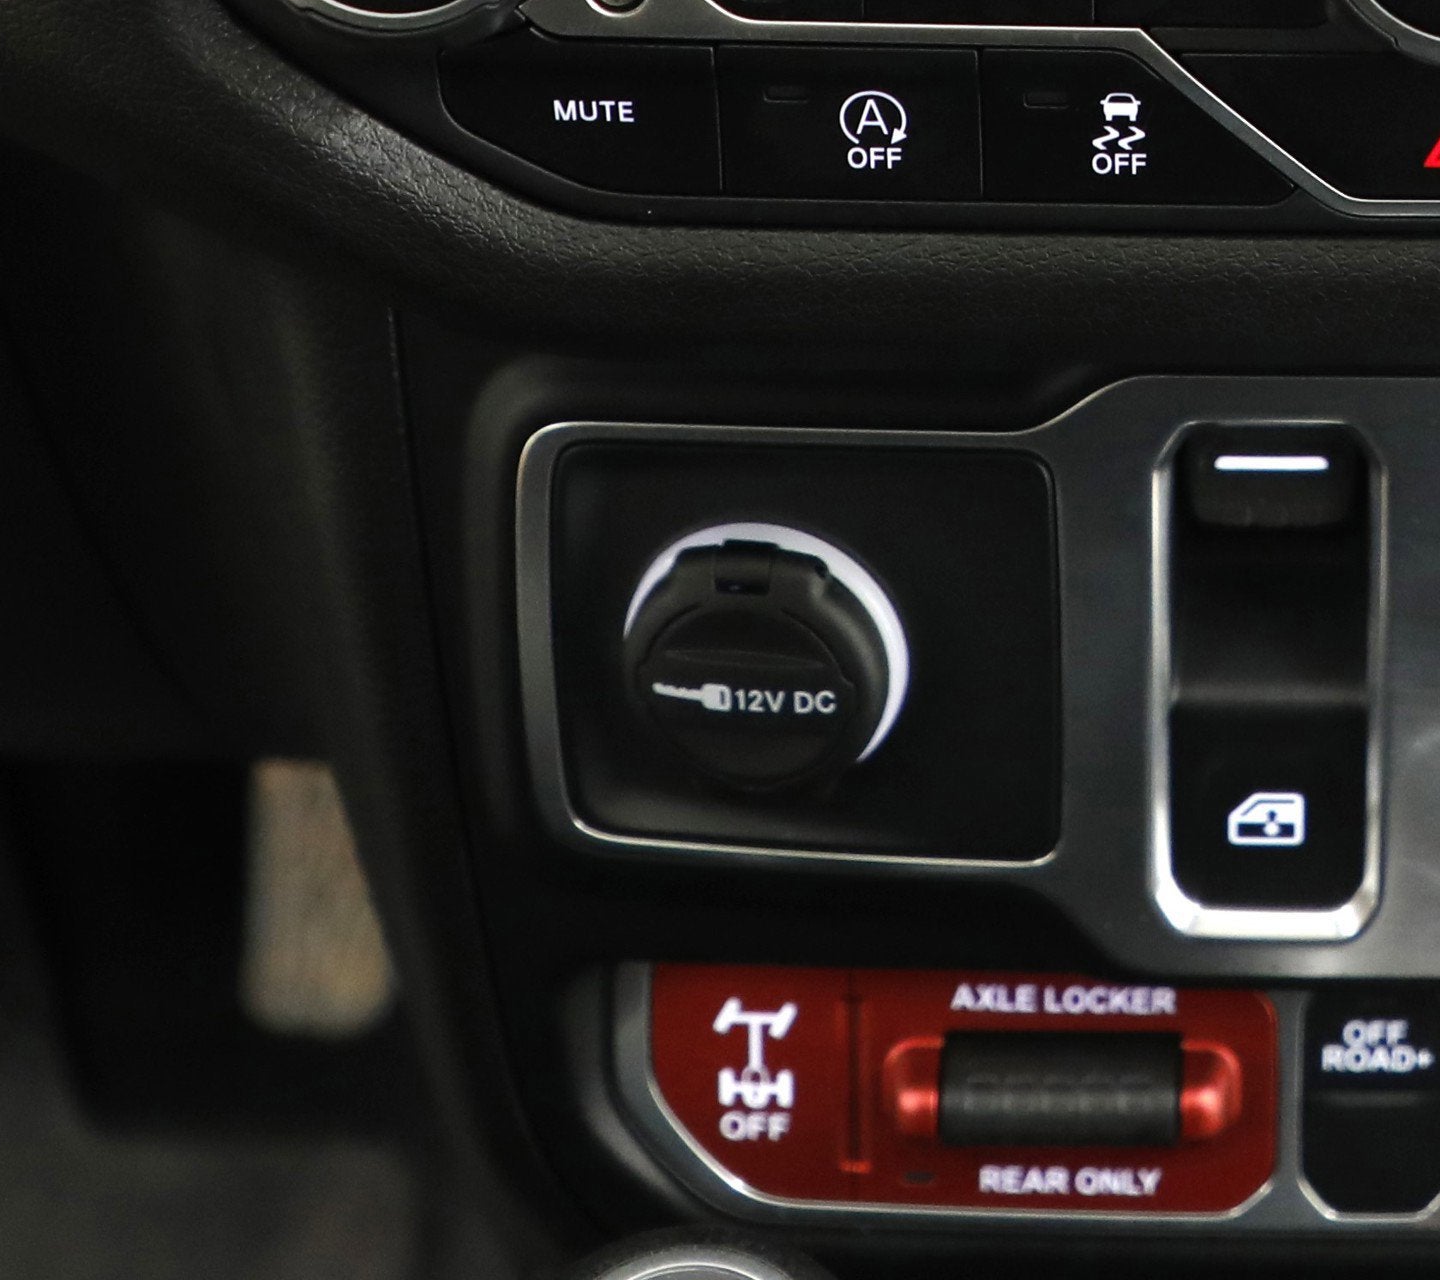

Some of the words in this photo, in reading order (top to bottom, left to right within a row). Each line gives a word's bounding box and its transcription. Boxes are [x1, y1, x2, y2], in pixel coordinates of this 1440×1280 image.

[553, 100, 635, 122] MUTE
[847, 146, 902, 170] OFF
[1091, 152, 1147, 175] OFF
[735, 690, 784, 713] 12V
[794, 690, 836, 715] DC
[951, 984, 1035, 1012] AXLE
[1043, 986, 1177, 1015] LOCKER
[1342, 1018, 1408, 1046] OFF
[1322, 1046, 1435, 1072] ROAD+
[720, 1113, 790, 1141] OFF
[979, 1167, 1067, 1194] REAR
[1075, 1167, 1162, 1196] ONLY
